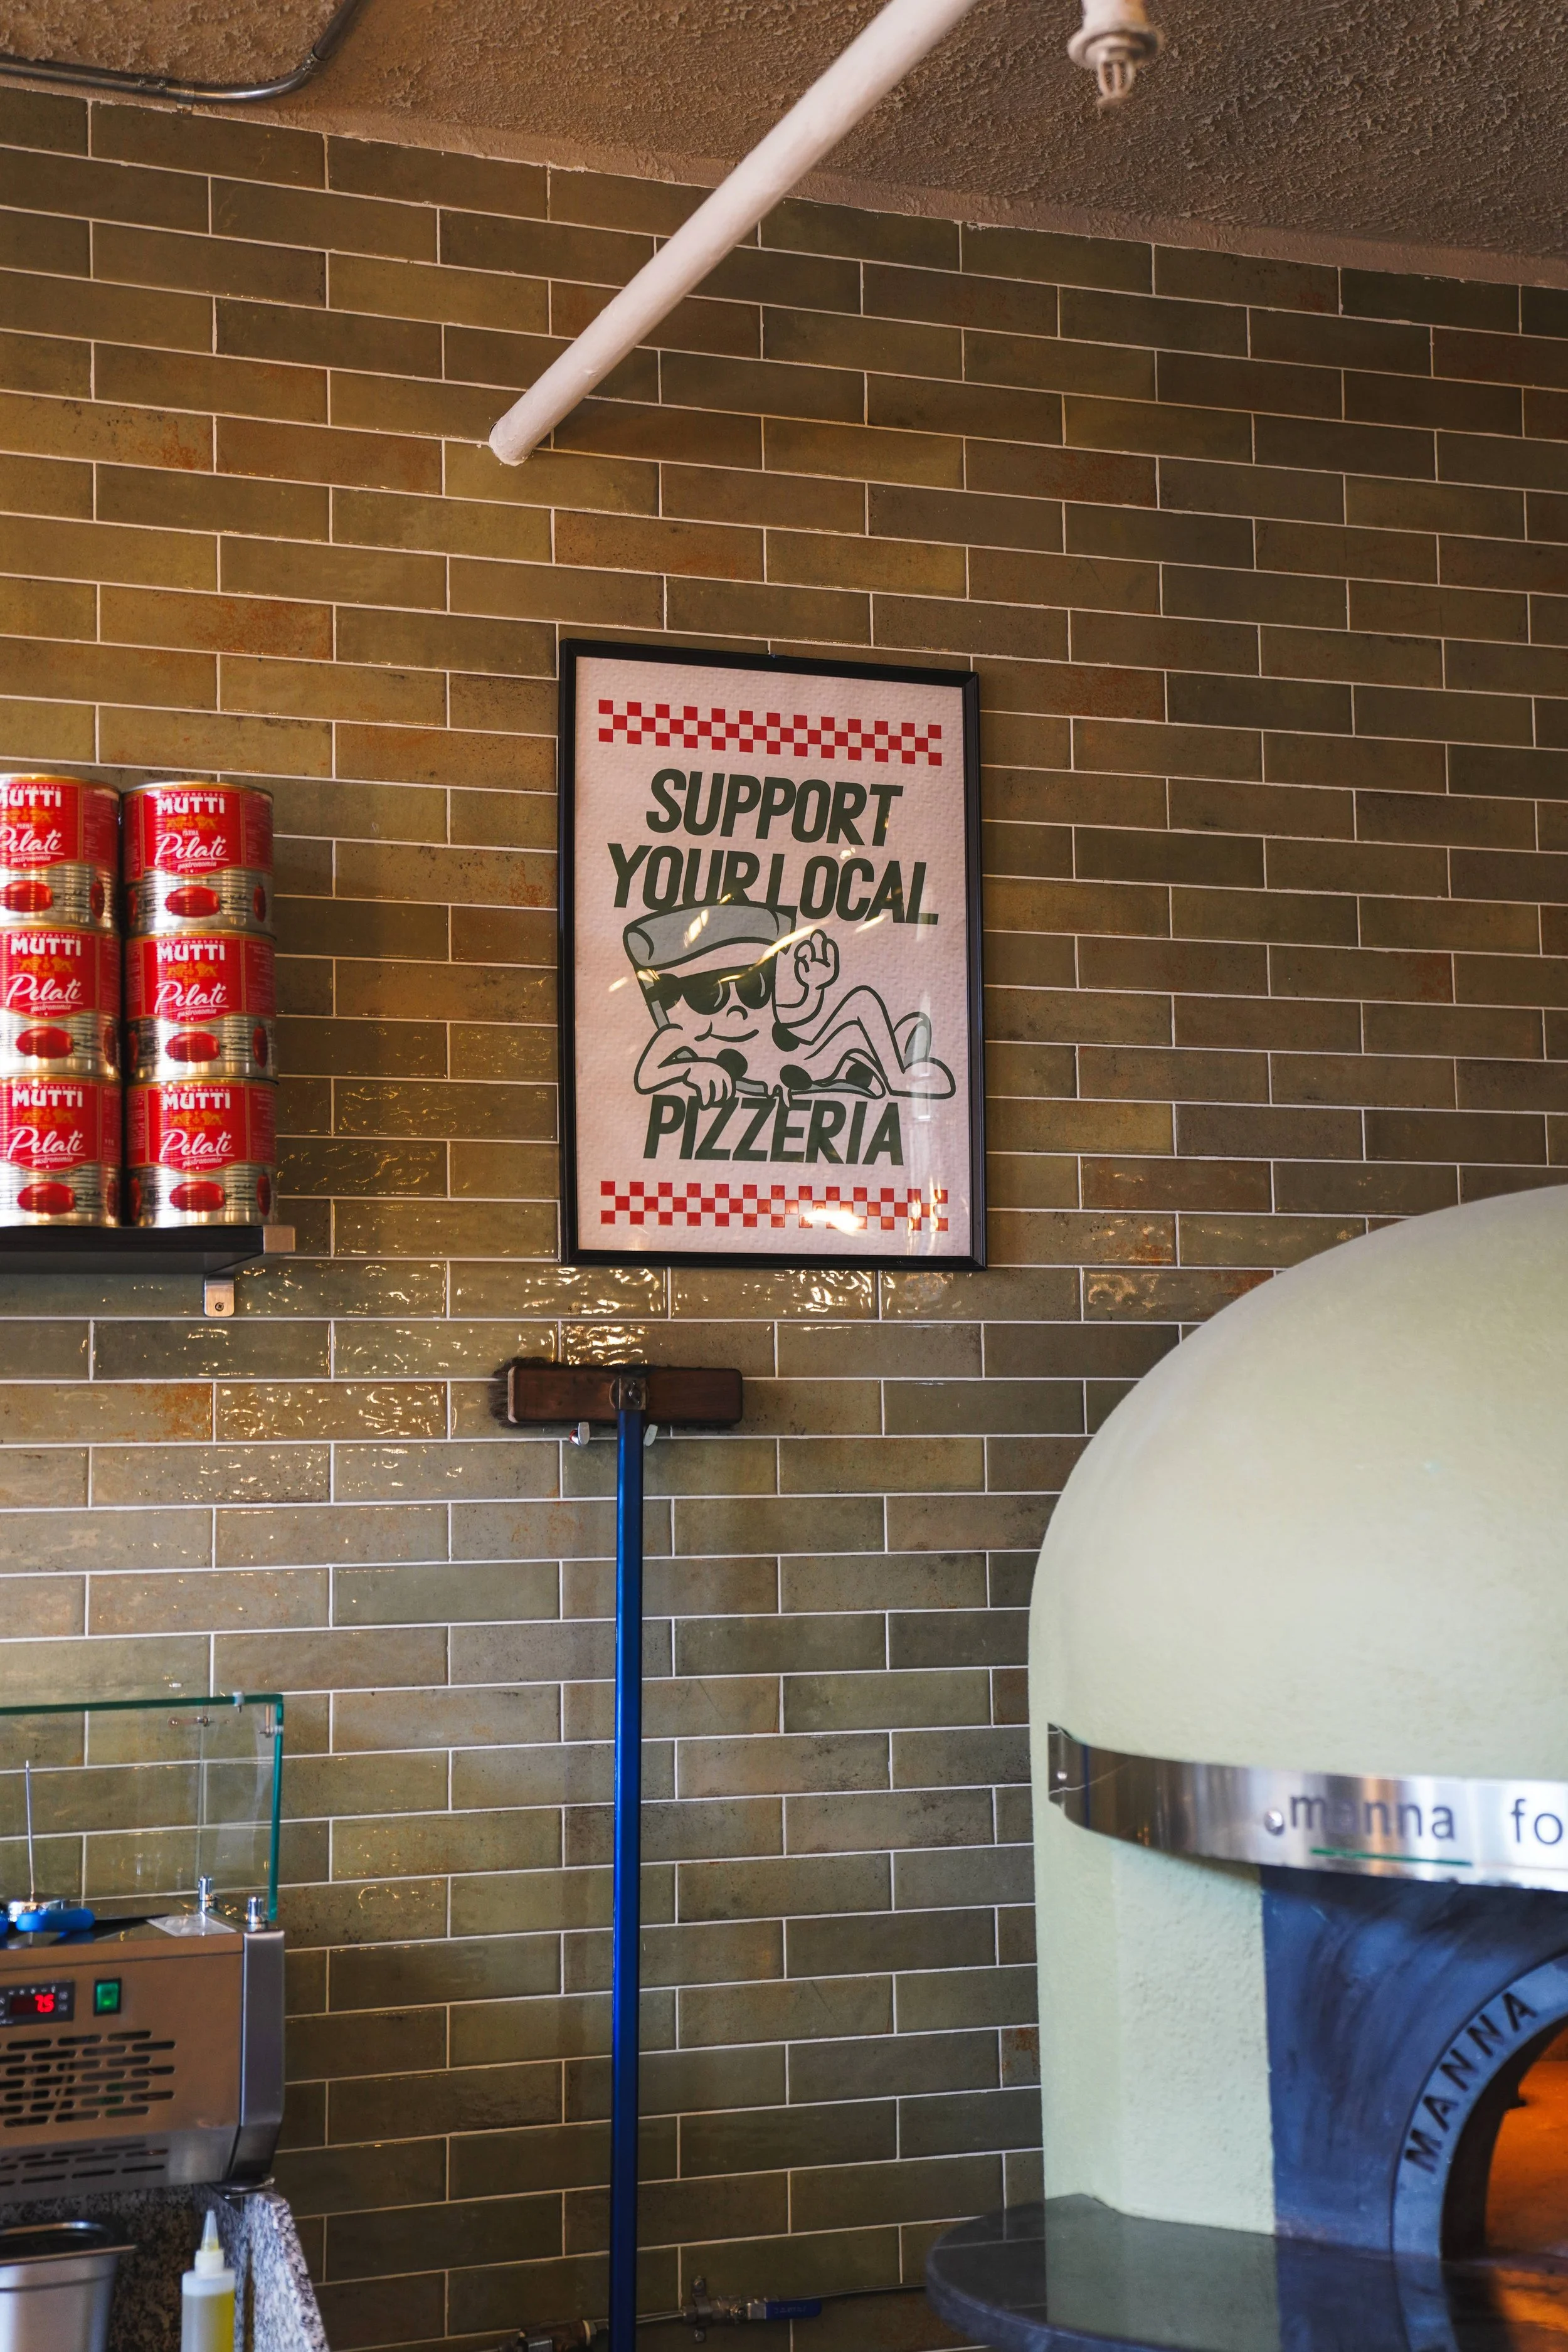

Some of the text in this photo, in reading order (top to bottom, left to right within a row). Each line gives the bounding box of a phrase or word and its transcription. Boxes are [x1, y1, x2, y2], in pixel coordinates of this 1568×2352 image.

[157, 797, 225, 815] MUTTI
[646, 768, 903, 846] SUPPORT
[154, 833, 226, 867] Pelati
[607, 843, 939, 924] YOUR LOCAL
[11, 938, 82, 956] MUTTI
[157, 945, 225, 962] MUTTI
[5, 974, 82, 1007] Pelati
[154, 980, 226, 1014] Pelati
[11, 1089, 83, 1108] MUTTI
[163, 1093, 231, 1110] MUTTI
[7, 1125, 83, 1160] Pelati
[159, 1128, 232, 1163] Pelati
[643, 1094, 904, 1166] PIZZERIA
[1510, 1798, 1563, 1845] fo
[1405, 1992, 1538, 2175] MANNA
